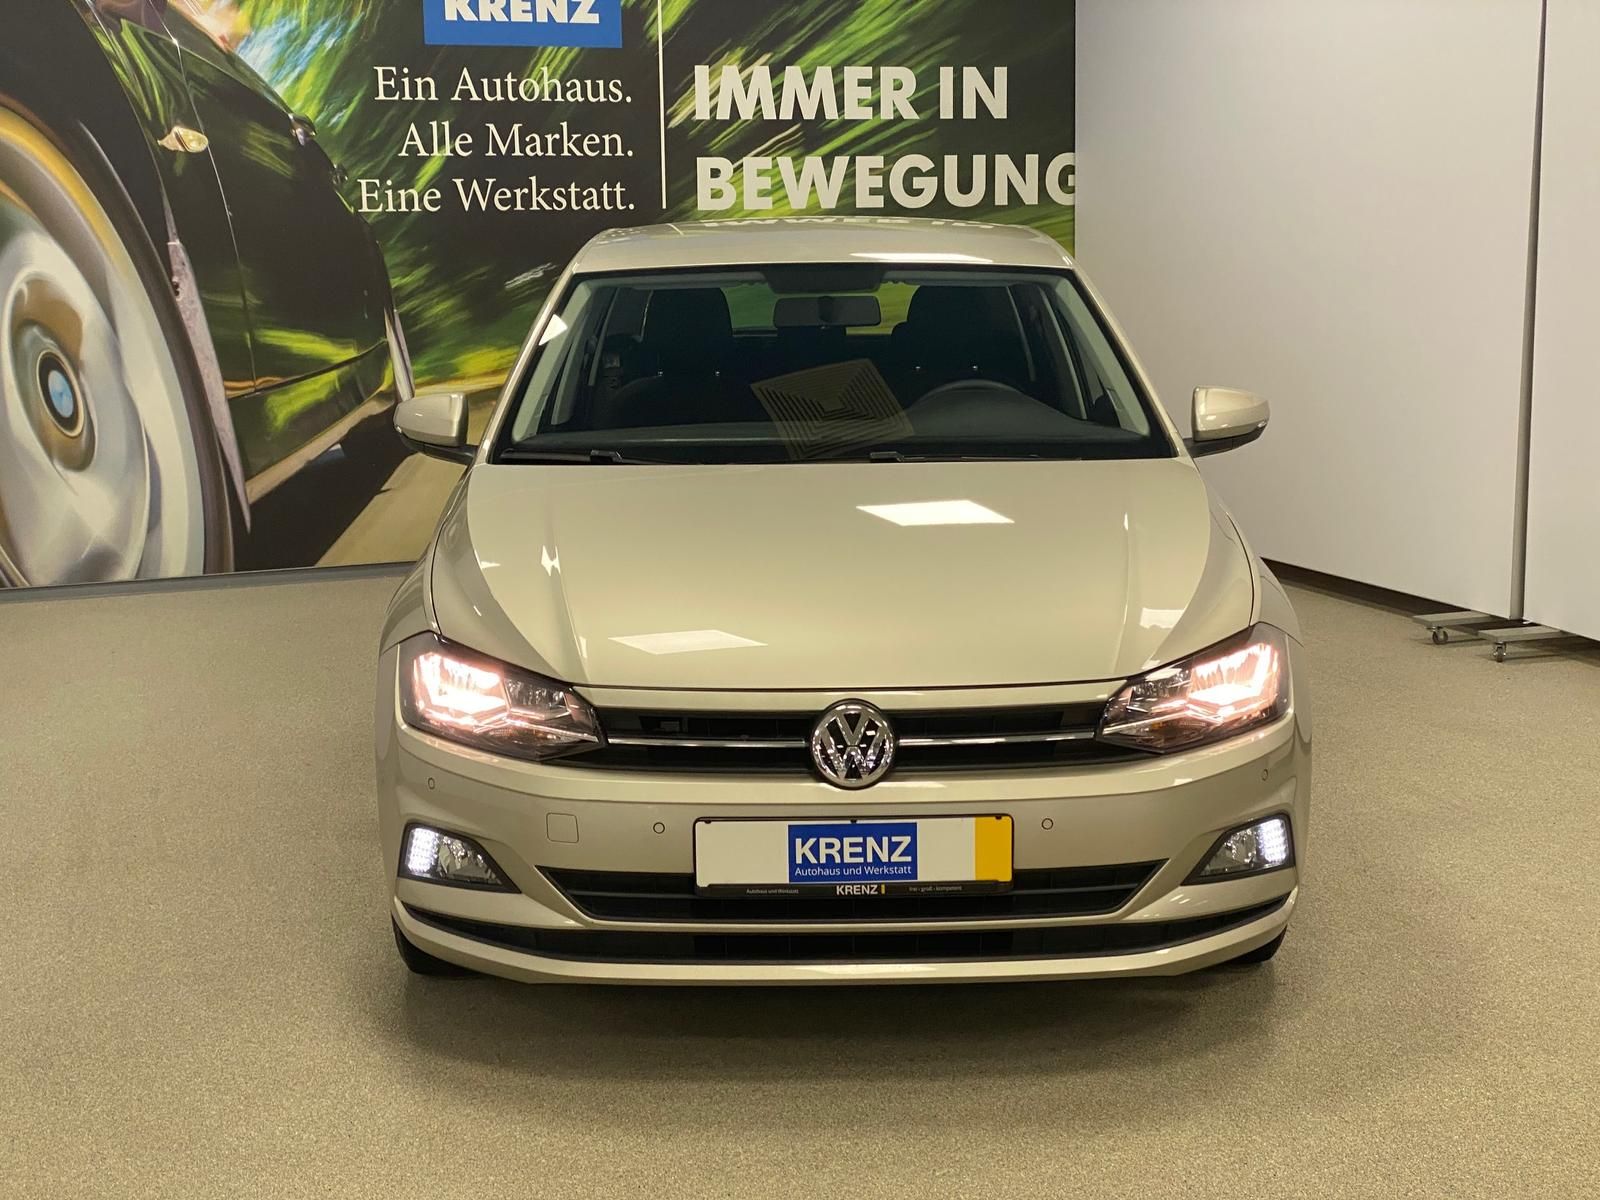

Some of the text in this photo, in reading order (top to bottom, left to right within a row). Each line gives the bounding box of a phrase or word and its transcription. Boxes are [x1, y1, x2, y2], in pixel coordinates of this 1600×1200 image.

[444, 0, 600, 24] KRENZ
[373, 65, 633, 103] Ein Autohaus.
[694, 65, 1008, 120] IMMER IN
[398, 120, 635, 157] Alle Marken.
[357, 175, 636, 213] Eine Werkstatt.
[696, 152, 1075, 211] BEWEGUNG
[795, 835, 912, 865] KRENZ
[794, 865, 912, 877] Autohaus und Werkstatt
[836, 884, 878, 896] KRENZ
